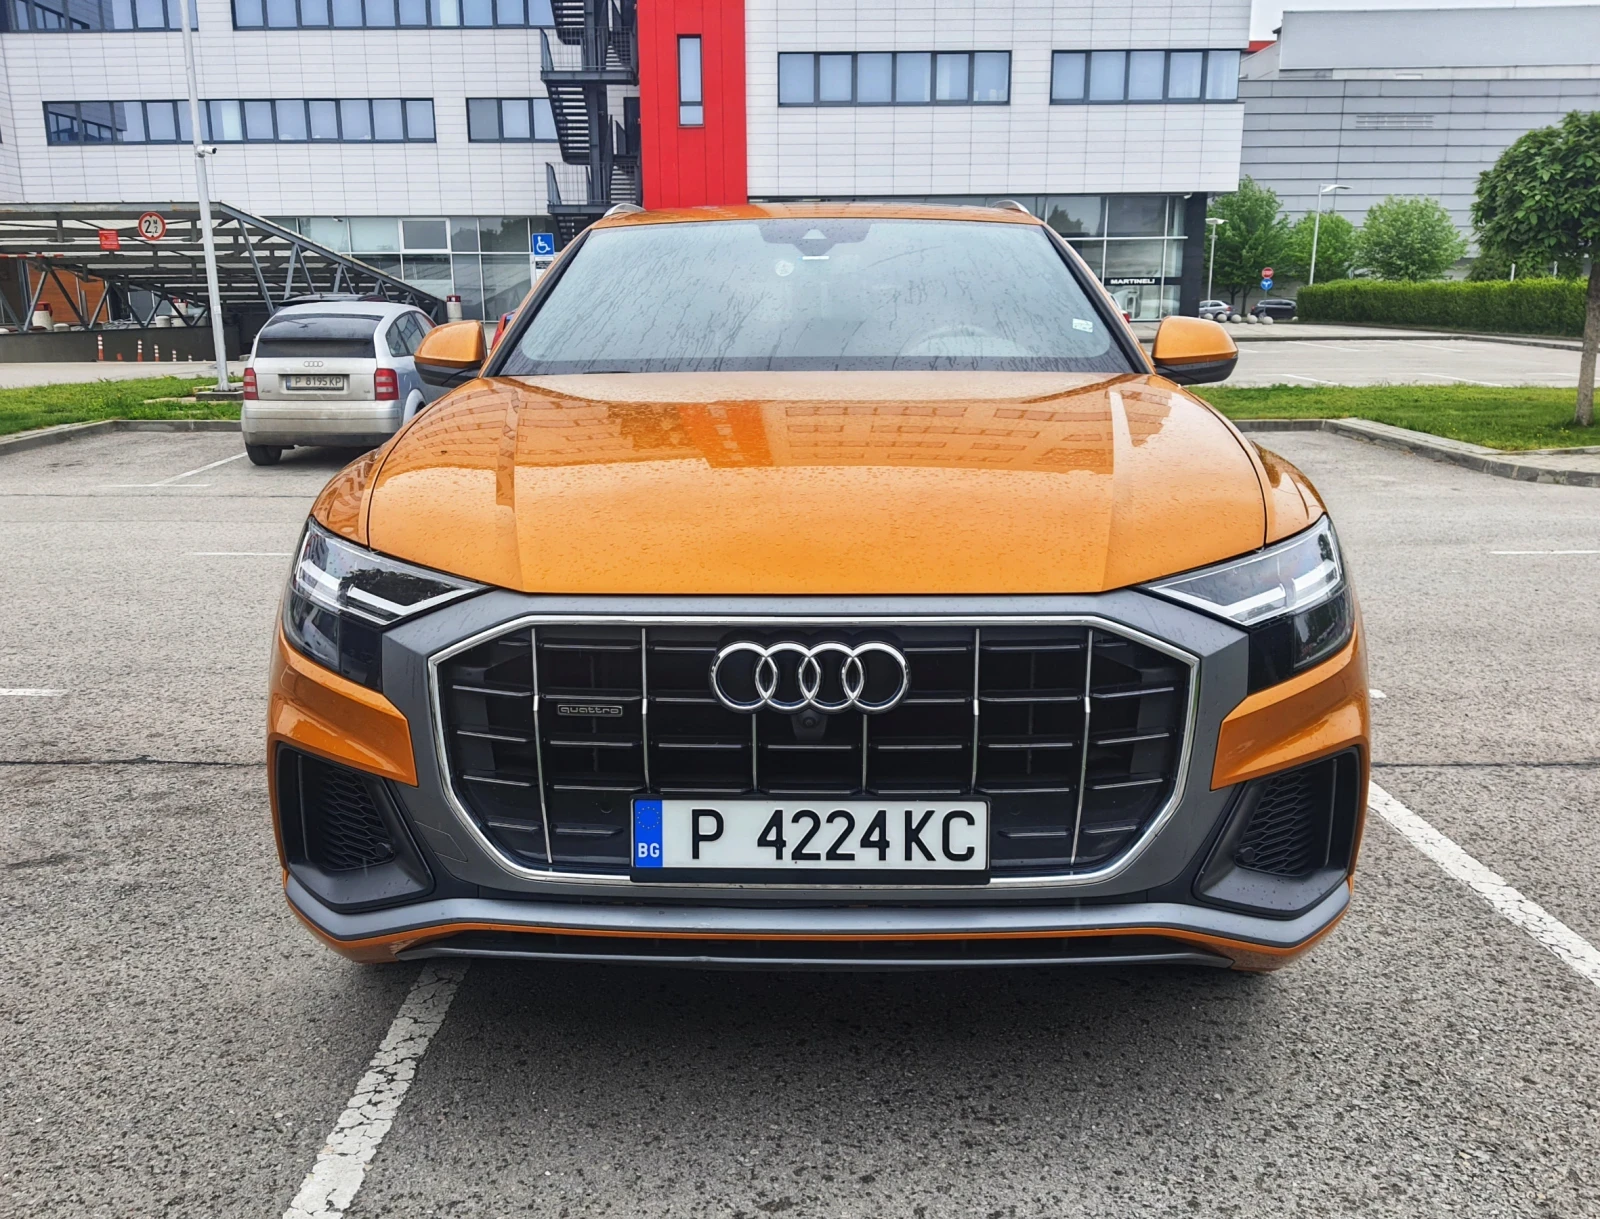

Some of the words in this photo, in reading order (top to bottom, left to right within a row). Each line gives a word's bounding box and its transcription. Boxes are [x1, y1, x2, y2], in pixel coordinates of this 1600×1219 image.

[295, 376, 301, 386] P
[560, 706, 619, 714] quattro
[691, 808, 724, 860] P
[637, 842, 660, 858] BG
